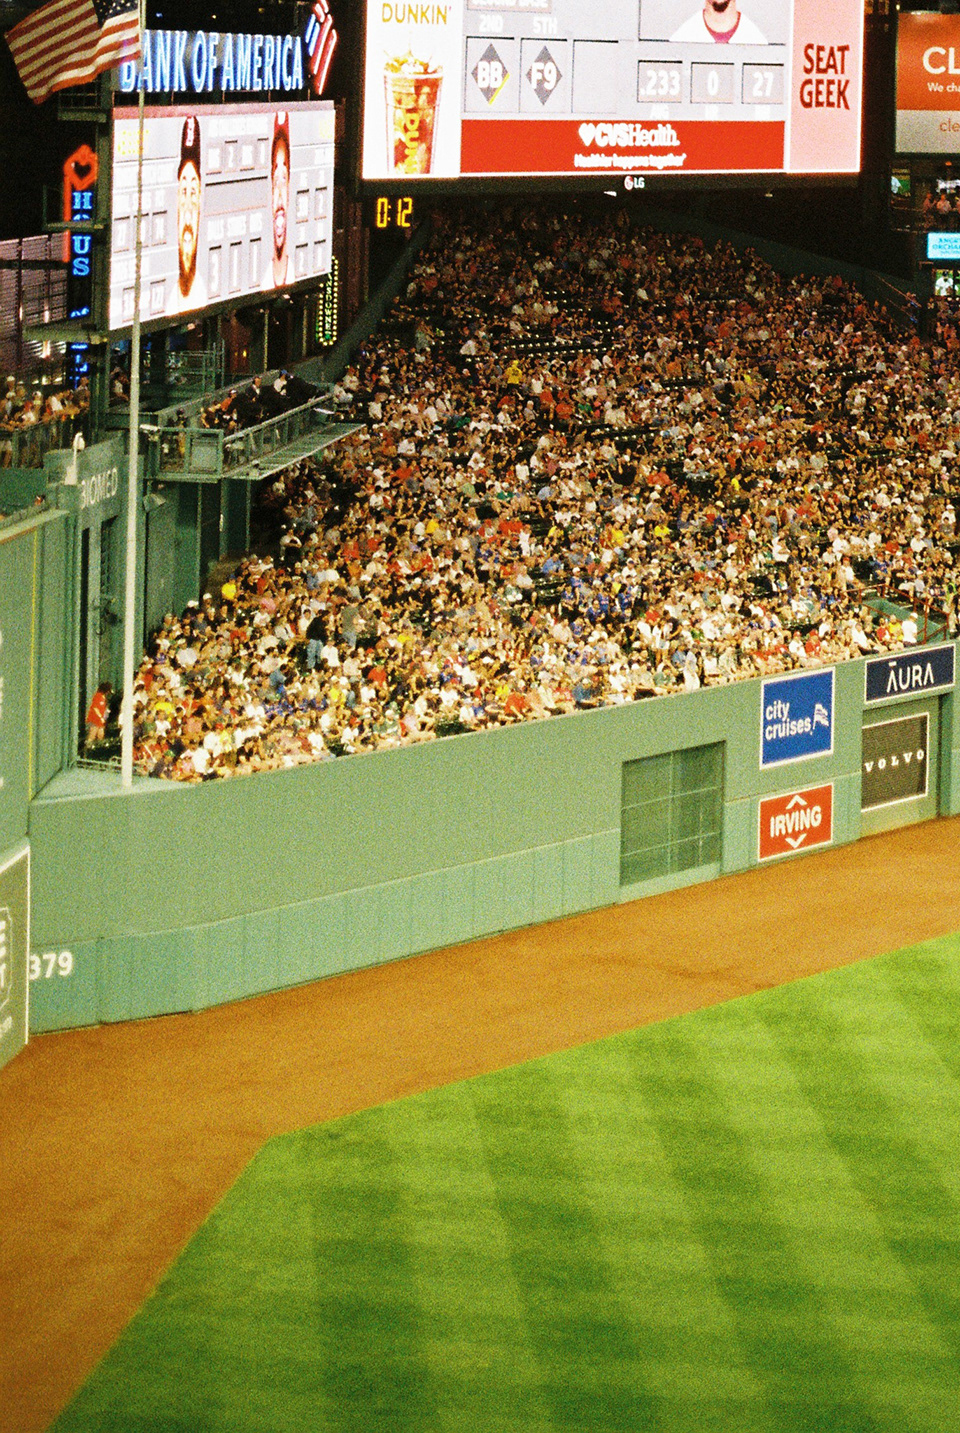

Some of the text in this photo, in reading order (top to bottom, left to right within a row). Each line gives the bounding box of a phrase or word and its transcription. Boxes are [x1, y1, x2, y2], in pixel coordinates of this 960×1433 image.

[382, 2, 451, 24] DUNKIN'
[479, 14, 558, 34] 2ND 5TH
[120, 30, 304, 93] BANK OF AMERICA
[803, 43, 850, 75] SEAT
[477, 61, 503, 89] BB
[531, 62, 557, 91] F9
[640, 70, 680, 96] .233
[707, 70, 719, 96] 0
[752, 71, 774, 97] 27
[928, 82, 945, 93] We
[800, 78, 850, 111] GEEK
[377, 197, 413, 228] 0:12
[765, 699, 790, 722] city
[864, 748, 926, 773] VOLVO
[769, 805, 822, 839] IRVING
[29, 951, 73, 980] 379
